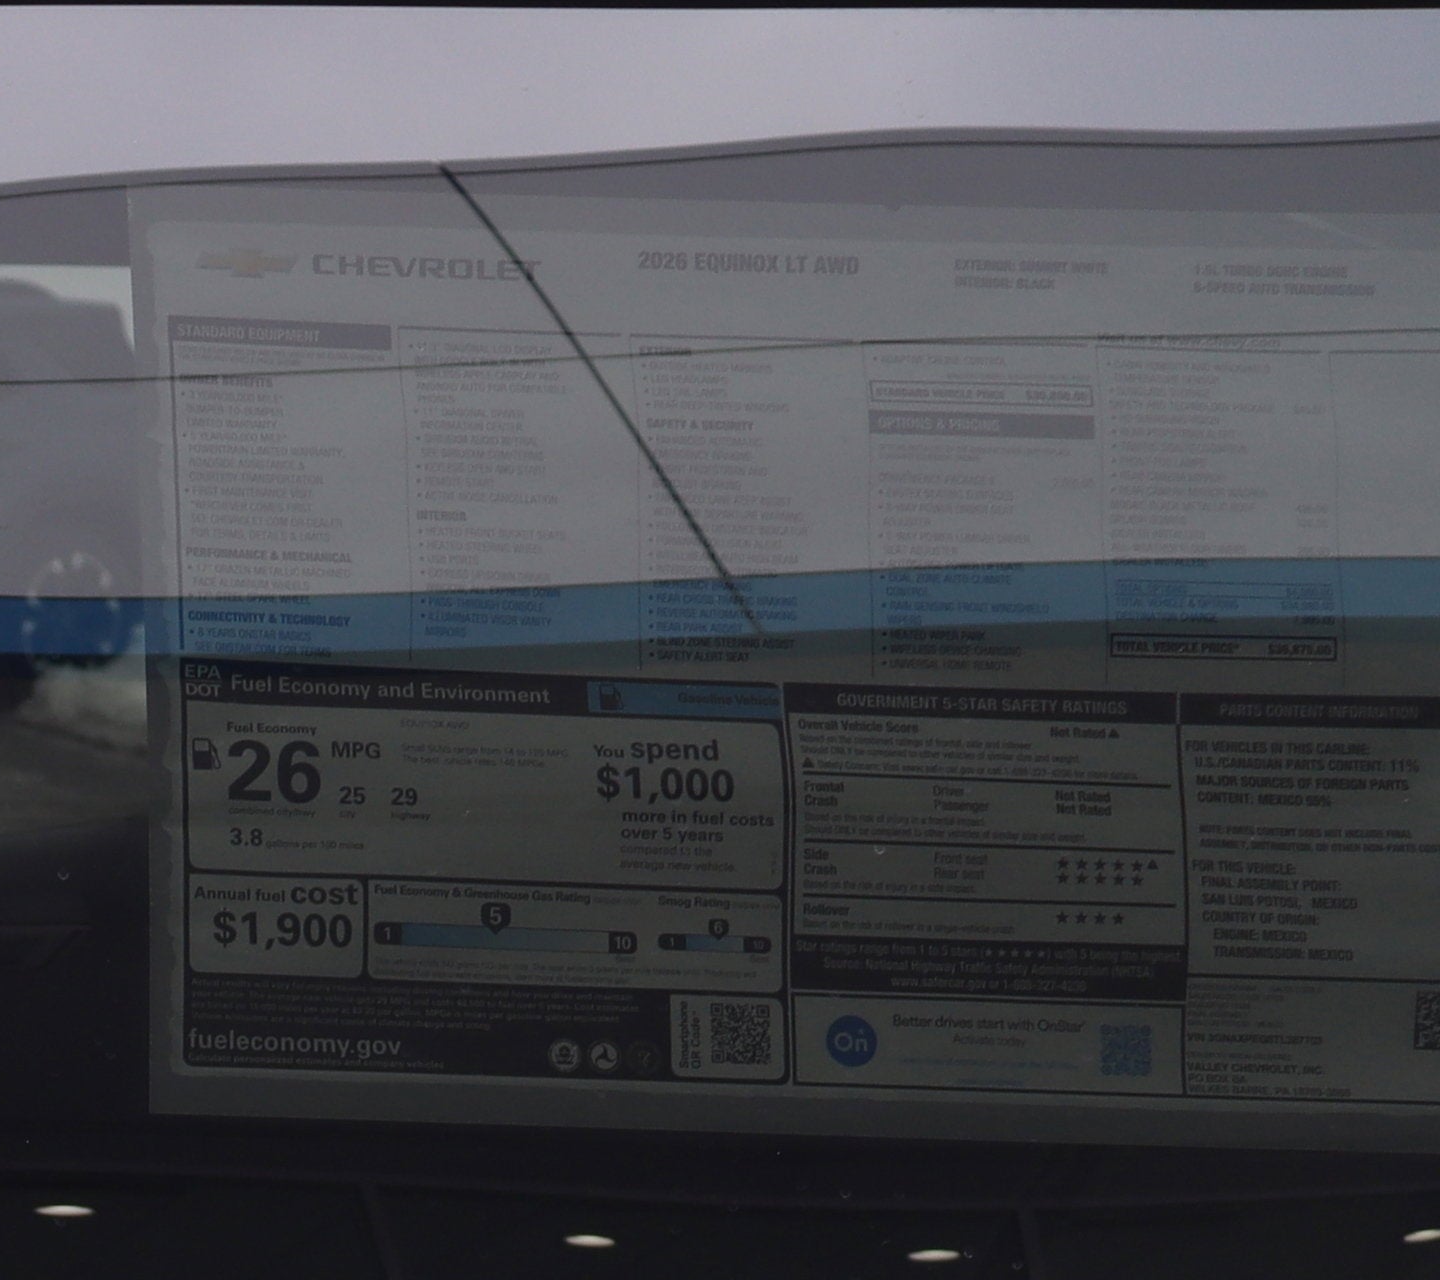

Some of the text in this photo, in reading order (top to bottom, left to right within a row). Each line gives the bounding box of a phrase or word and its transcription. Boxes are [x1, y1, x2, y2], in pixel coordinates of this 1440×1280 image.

[638, 252, 859, 275] 2026 EQUINOX LT AWD
[184, 664, 221, 679] EPA
[185, 683, 222, 697] DOT
[231, 674, 551, 704] Fuel Economy and Environment
[678, 691, 779, 707] Gasoline Vehicle
[837, 694, 1127, 715] GOVERNMENT 5-STAR SAFETY RATINGS
[1219, 704, 1419, 719] PARTS CONTENT INFORMATION
[226, 722, 317, 736] Fuel Economy
[798, 720, 1106, 739] Overall Vehicle Score Not Rated
[593, 744, 625, 759] You
[630, 739, 719, 764] spend
[1185, 740, 1208, 751] FOR
[1212, 741, 1267, 753] VEHICLES
[1270, 742, 1282, 754] IN
[1288, 743, 1312, 754] THIS
[228, 740, 320, 803] 26
[331, 741, 381, 759] MPG
[596, 763, 734, 804] $1,000
[804, 781, 844, 794] Frontal
[932, 785, 964, 797] Driver
[339, 786, 365, 804] 25
[392, 788, 418, 806] 29
[804, 795, 838, 807] Crash
[1055, 791, 1111, 803] Not Rated
[934, 800, 990, 814] Passenger
[1057, 804, 1112, 817] Not Rated
[621, 810, 774, 827] more in fuel costs
[230, 828, 262, 847] 3.8
[621, 828, 723, 844] over 5 years
[804, 848, 829, 861] Side
[934, 852, 988, 865] Front seat
[804, 864, 837, 876] Crash
[1192, 860, 1214, 871] FOR
[1218, 860, 1243, 873] THIS
[934, 868, 985, 881] Rear seat
[194, 884, 358, 905] Annual fuel cost
[374, 884, 398, 896] Fuel
[400, 886, 450, 900] Economy
[452, 887, 461, 898] &
[464, 888, 529, 901] Greenhouse
[532, 890, 552, 902] Gas
[555, 891, 590, 905] Rating
[658, 896, 690, 910] Smog
[693, 897, 730, 910] Rating
[803, 904, 850, 917] Rollover
[489, 907, 502, 924] 5
[213, 907, 352, 950] $1,900
[383, 925, 391, 940] 1
[714, 921, 723, 934] 6
[613, 936, 631, 951] 10
[892, 1015, 932, 1029] Better
[934, 1015, 971, 1029] drives
[975, 1018, 1005, 1030] start
[1007, 1019, 1034, 1032] with
[679, 1001, 689, 1069] Smartphone
[952, 1035, 993, 1047] Activate
[188, 1028, 401, 1059] fueleconomy.gov
[834, 1033, 868, 1053] On
